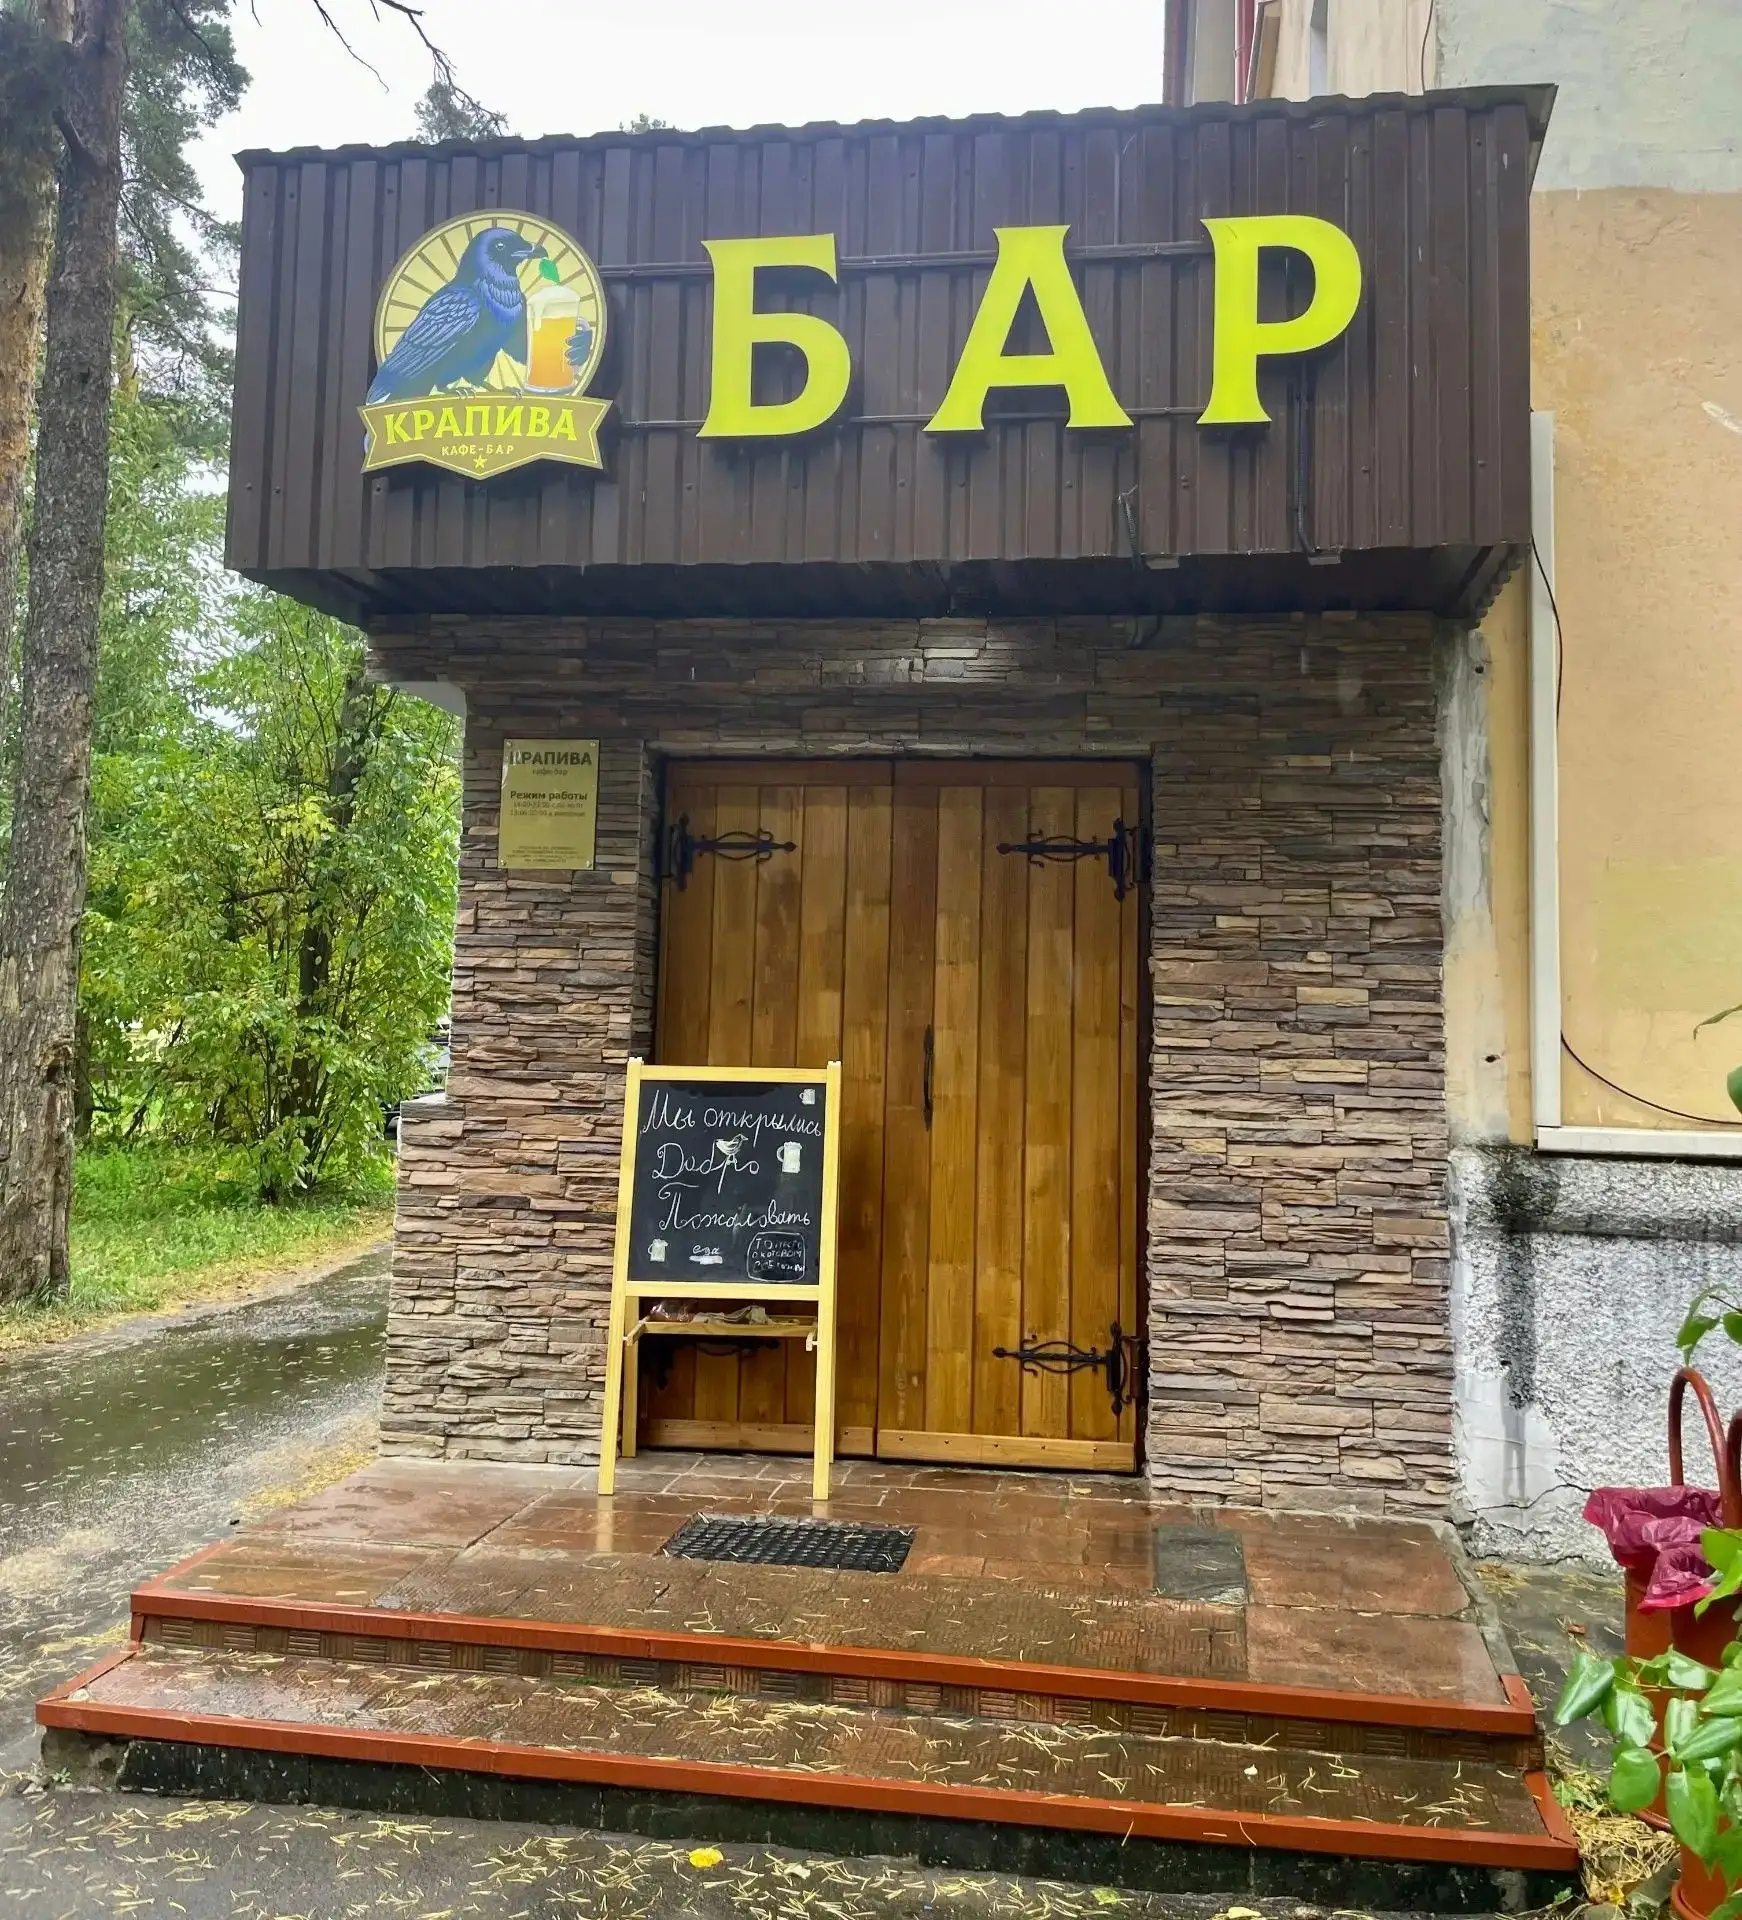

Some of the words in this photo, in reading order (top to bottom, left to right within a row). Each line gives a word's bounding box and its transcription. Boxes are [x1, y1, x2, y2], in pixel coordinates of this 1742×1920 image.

[696, 215, 1362, 437] БАР
[383, 405, 578, 445] КРАПИВА
[441, 443, 514, 456] КАФЕ-БАР
[509, 751, 592, 766] КРАПИВА
[510, 790, 546, 800] Режим
[548, 790, 588, 802] работы
[640, 1089, 696, 1134] Мы
[703, 1107, 822, 1148] открылись
[651, 1140, 760, 1195] Добро
[657, 1182, 811, 1231] Пожаловать
